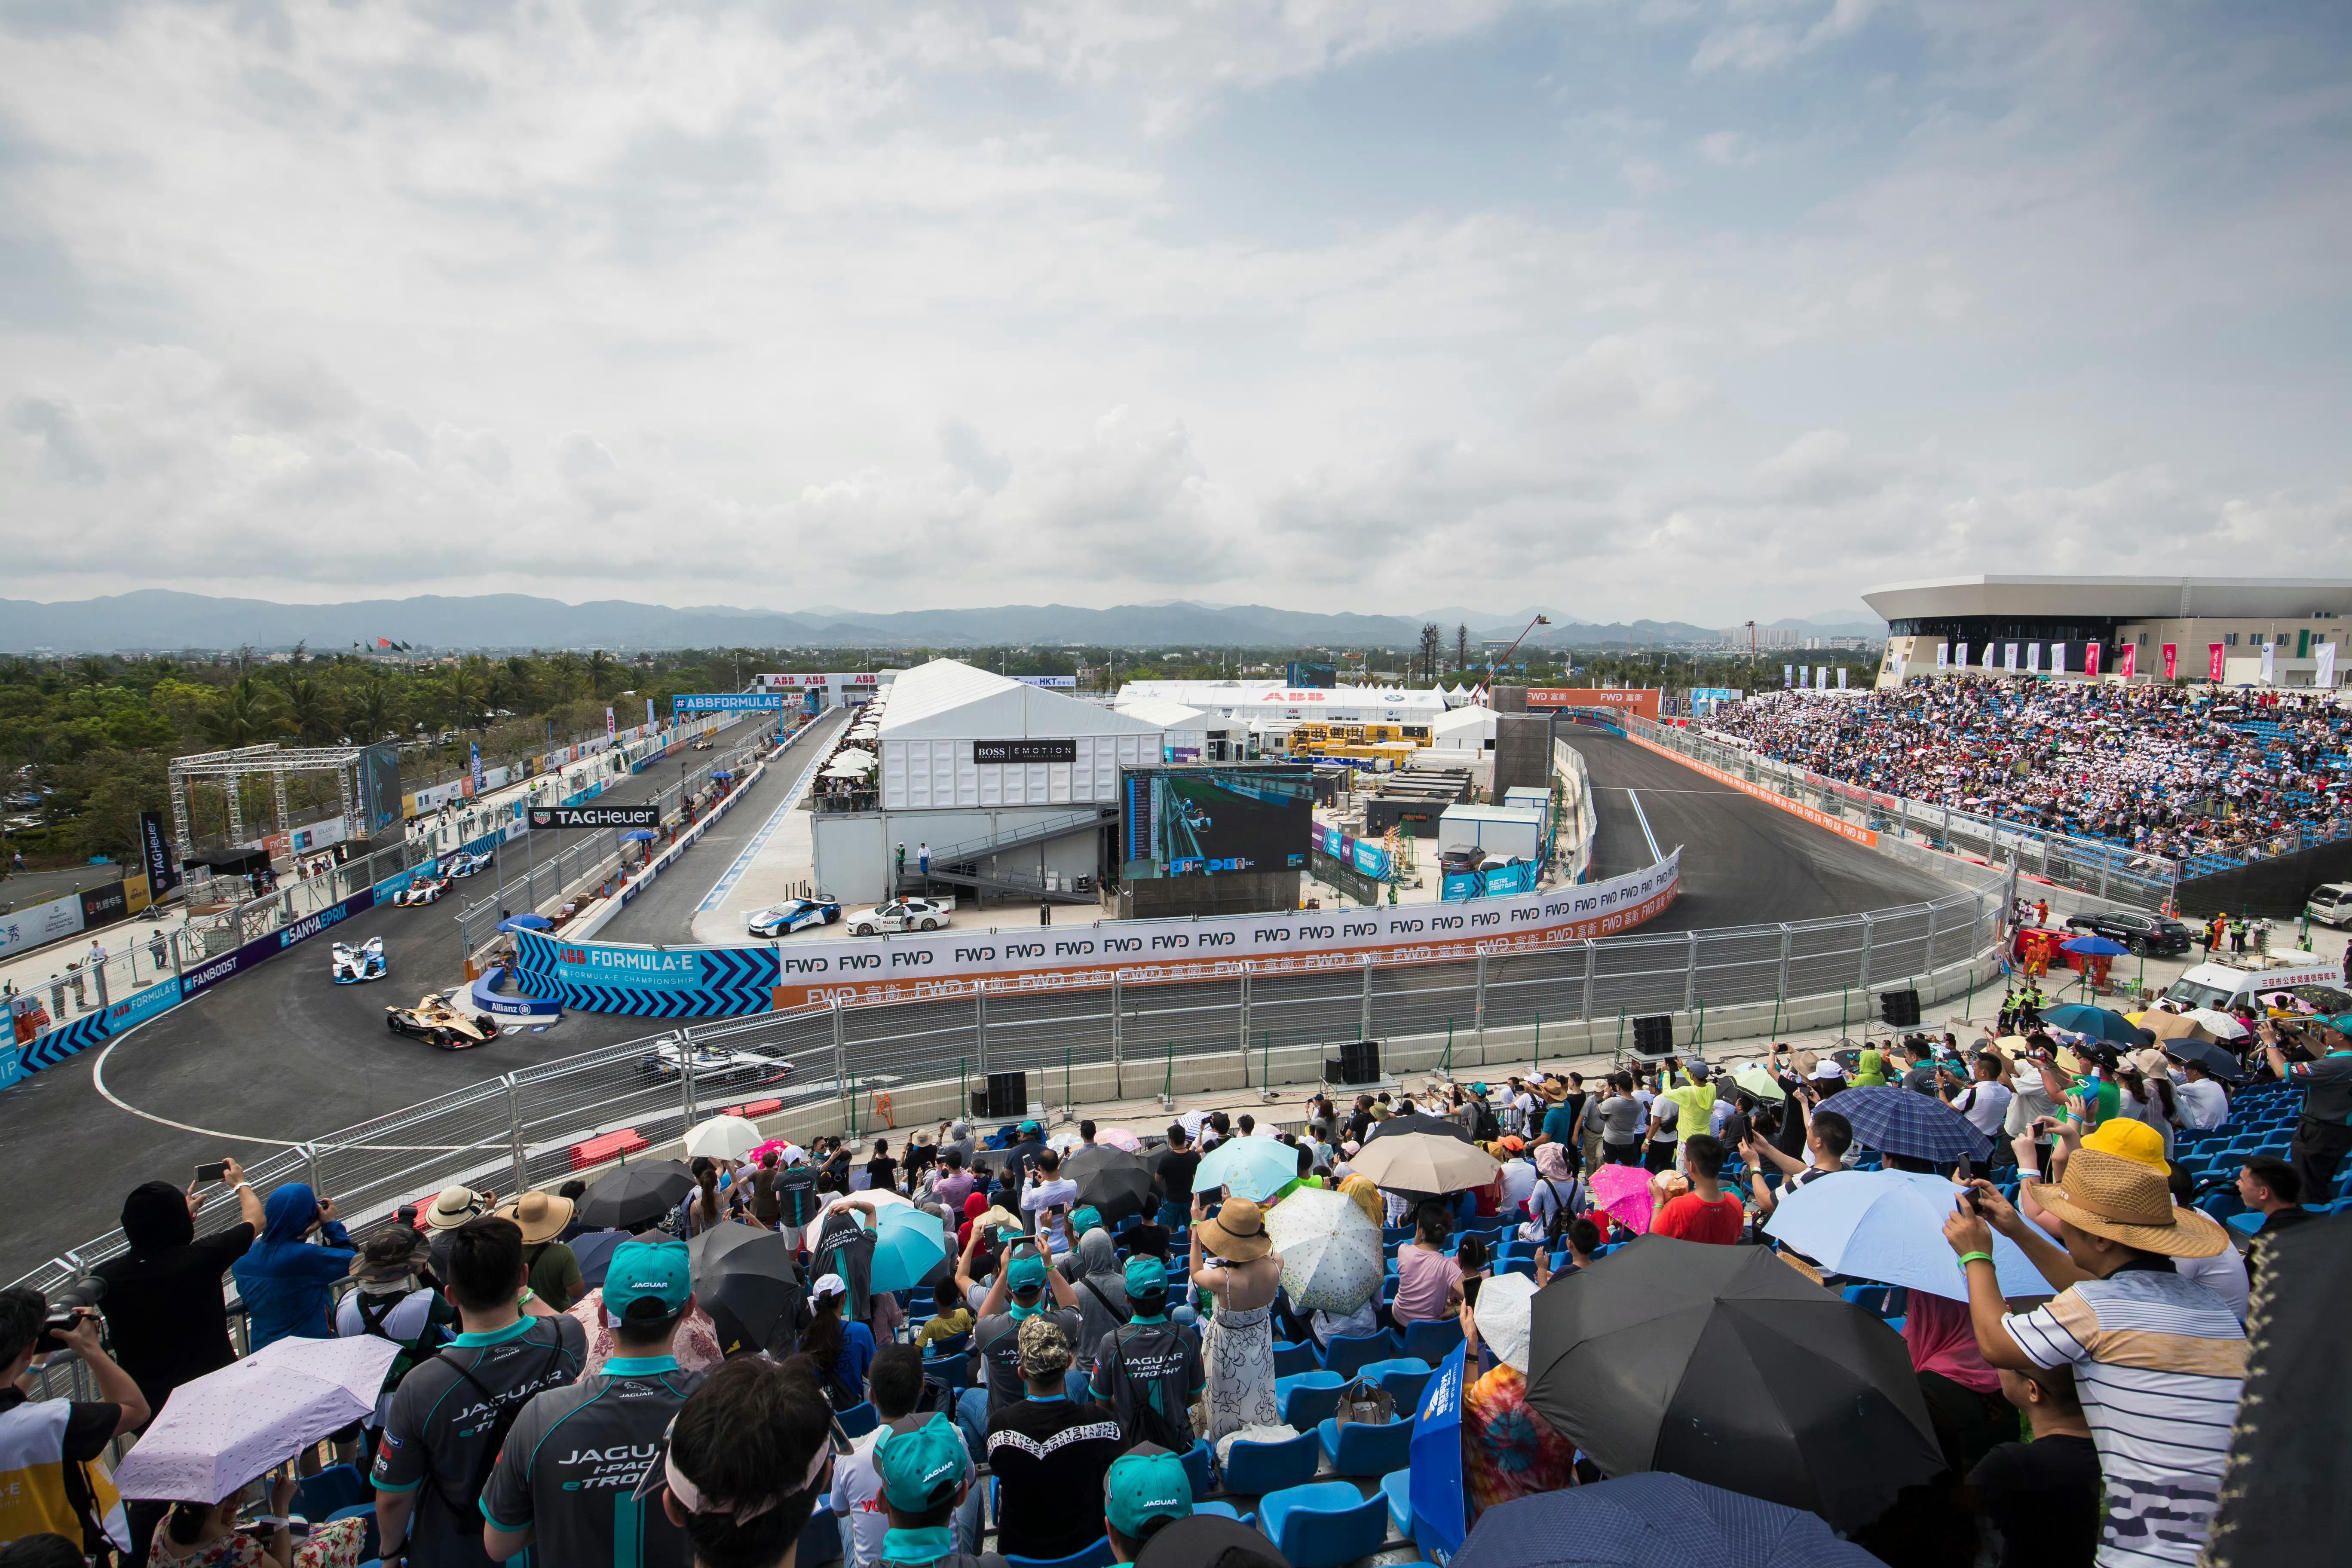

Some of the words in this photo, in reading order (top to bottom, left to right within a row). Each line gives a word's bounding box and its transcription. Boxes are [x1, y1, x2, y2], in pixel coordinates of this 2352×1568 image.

[773, 677, 795, 685] ABB
[804, 676, 826, 684] ABB
[676, 697, 780, 707] #ABBFORMULAE
[1262, 692, 1325, 701] ABB
[1788, 802, 1796, 812] FWD
[556, 811, 654, 824] TAGHeuer
[1805, 809, 1813, 820] FWD
[1823, 817, 1833, 828] FWD
[1834, 821, 1842, 832] 富衛
[1844, 825, 1856, 837] FWD
[1857, 830, 1868, 842] 富衛
[150, 820, 165, 876] TAGHeuer
[1359, 851, 1376, 861] FIERCELY
[1359, 858, 1375, 869] DRIVEN
[1489, 878, 1508, 886] ELECTRIC
[1505, 880, 1517, 889] RACING
[96, 896, 122, 911] 礼橙专车
[281, 904, 346, 944] #SANYAEPRIX
[786, 958, 828, 974] FWD
[839, 955, 881, 971] FWD
[892, 951, 933, 967] FWD
[955, 947, 995, 962] FWD
[1006, 943, 1045, 959] FWD
[1055, 941, 1094, 956] FWD
[1104, 938, 1142, 952] FWD
[1152, 935, 1189, 949] FWD
[1199, 932, 1235, 946] FWD
[1255, 928, 1290, 943] FWD
[1299, 926, 1335, 940] FWD
[1344, 923, 1377, 937] FWD
[1390, 920, 1424, 934] FWD
[1432, 916, 1464, 930] FWD
[1472, 912, 1500, 927] FWD
[1511, 908, 1540, 922] FWD
[1546, 903, 1569, 917] FWD
[1575, 897, 1597, 912] FWD
[1601, 891, 1617, 906] FWD
[1621, 886, 1638, 900] FWD
[1641, 879, 1652, 894] FWD
[1657, 872, 1667, 886] FWD
[1547, 927, 1574, 940] FWD
[1577, 922, 1597, 938] 富衛
[1602, 915, 1622, 933] FWD
[1625, 909, 1638, 925] 富衛
[1642, 901, 1654, 918] FWD
[1656, 895, 1665, 910] 富衛
[8, 924, 19, 943] 秀
[2101, 927, 2126, 935] EXTRICATION
[559, 948, 586, 965] ABB
[592, 950, 693, 971] FORMULA-E
[184, 957, 237, 991] #FANBOOST
[560, 969, 568, 978] FIA
[570, 971, 619, 981] FORMULA-E
[625, 976, 694, 985] CHAMPIONSHIP
[2262, 972, 2337, 987] 三亚市公安局通信指挥车
[113, 1003, 129, 1020] ABB
[131, 981, 176, 1010] FORMULA-E
[492, 1002, 517, 1013] Allianz
[827, 1235, 848, 1246] I-PACE
[493, 1349, 520, 1361] JAGUAR
[1124, 1352, 1183, 1365] JAGUAR
[559, 1443, 659, 1464] JAGU
[594, 1461, 653, 1474] I-PAC
[923, 1461, 954, 1482] JAGUAR
[562, 1472, 647, 1491] eTRO
[1144, 1499, 1177, 1507] JAGUAR
